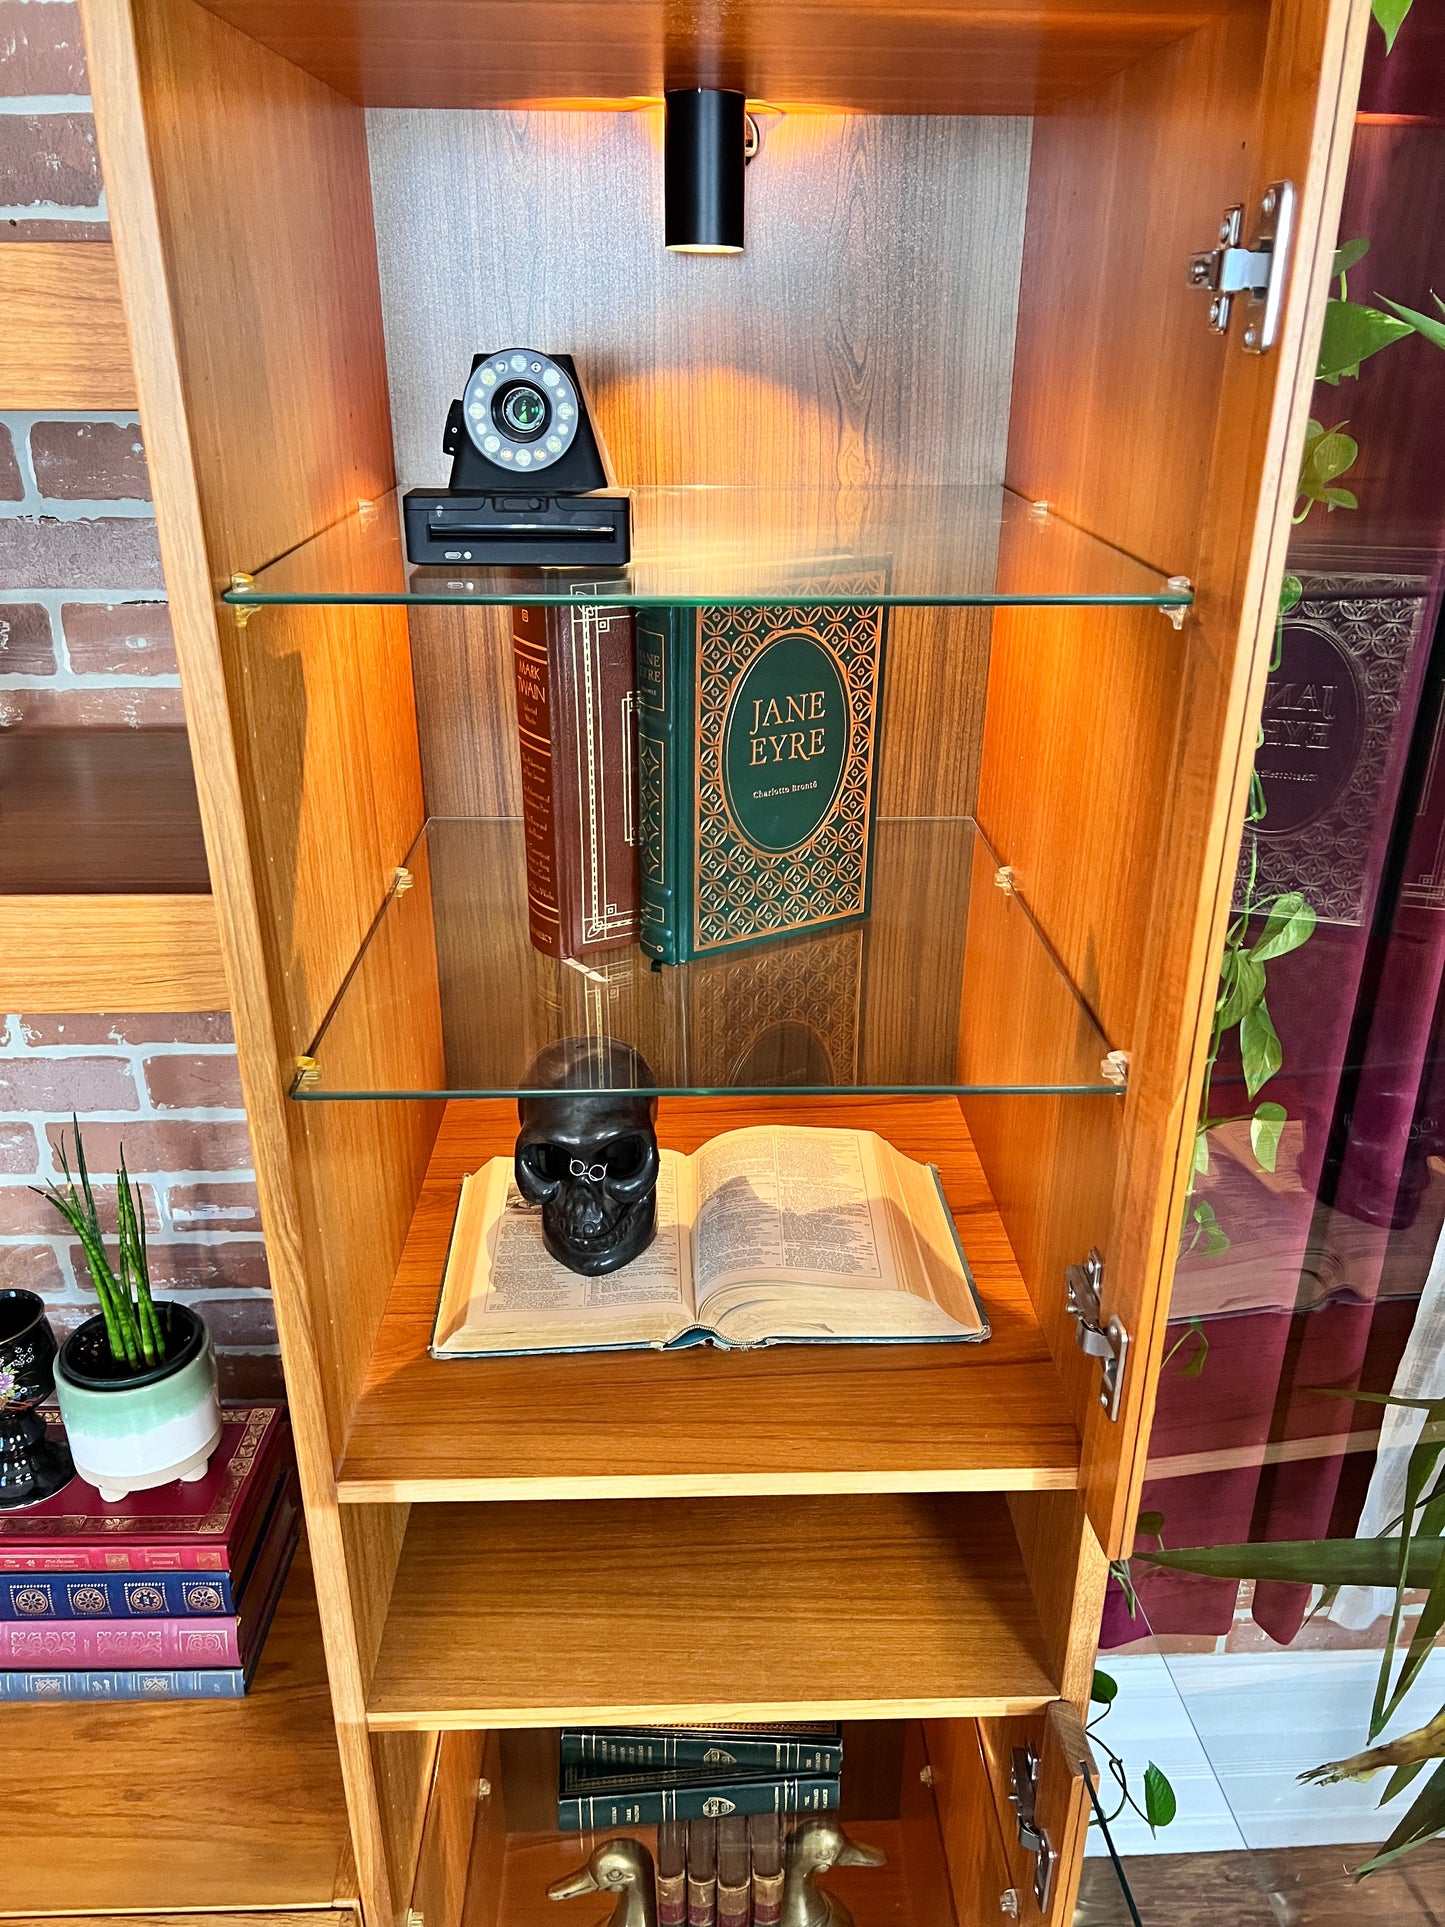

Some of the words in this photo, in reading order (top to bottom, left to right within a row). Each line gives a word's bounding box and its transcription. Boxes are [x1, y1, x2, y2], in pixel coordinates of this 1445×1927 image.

[519, 660, 541, 681] MARK
[517, 674, 546, 704] TWAIN
[749, 690, 826, 735] JANE
[749, 728, 826, 766] EYRE
[753, 786, 790, 799] Charlotte
